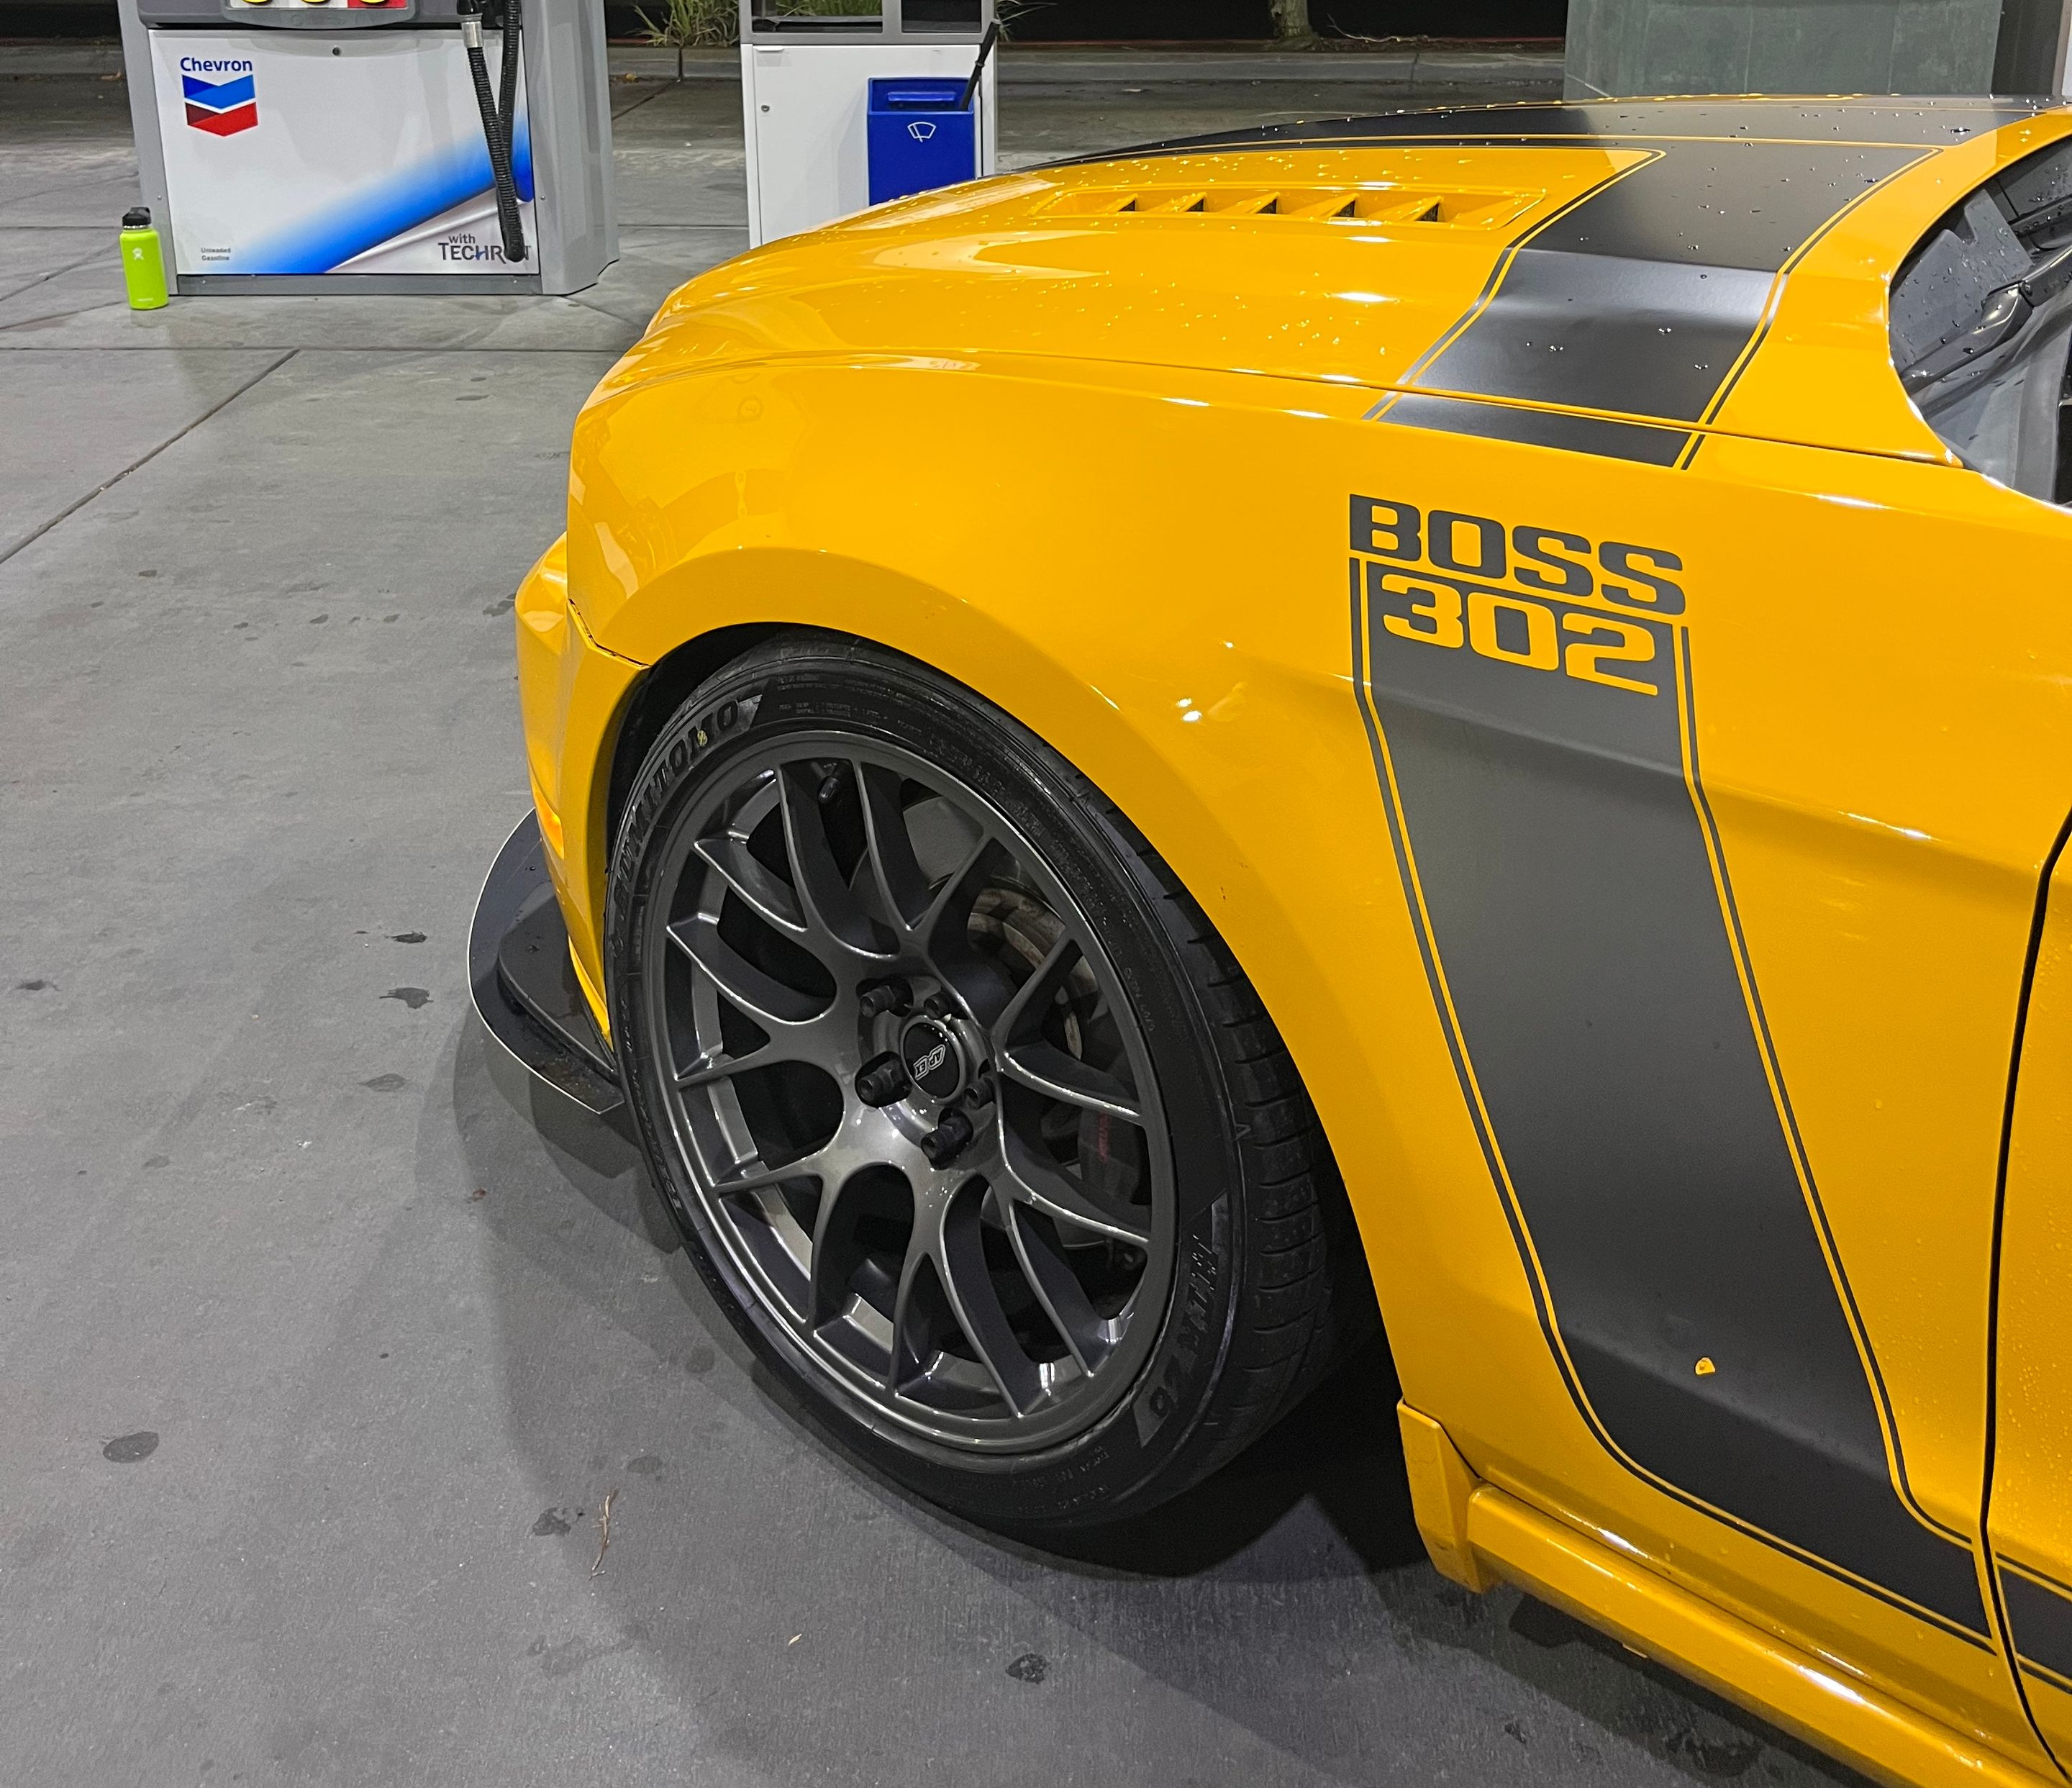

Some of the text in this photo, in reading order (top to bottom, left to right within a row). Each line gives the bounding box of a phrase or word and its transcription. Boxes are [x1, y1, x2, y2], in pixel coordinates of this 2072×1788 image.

[180, 57, 253, 71] Chevron
[449, 233, 476, 243] with
[438, 242, 530, 263] TECHR
[1349, 494, 1686, 614] BOSS
[1381, 573, 1658, 696] 302
